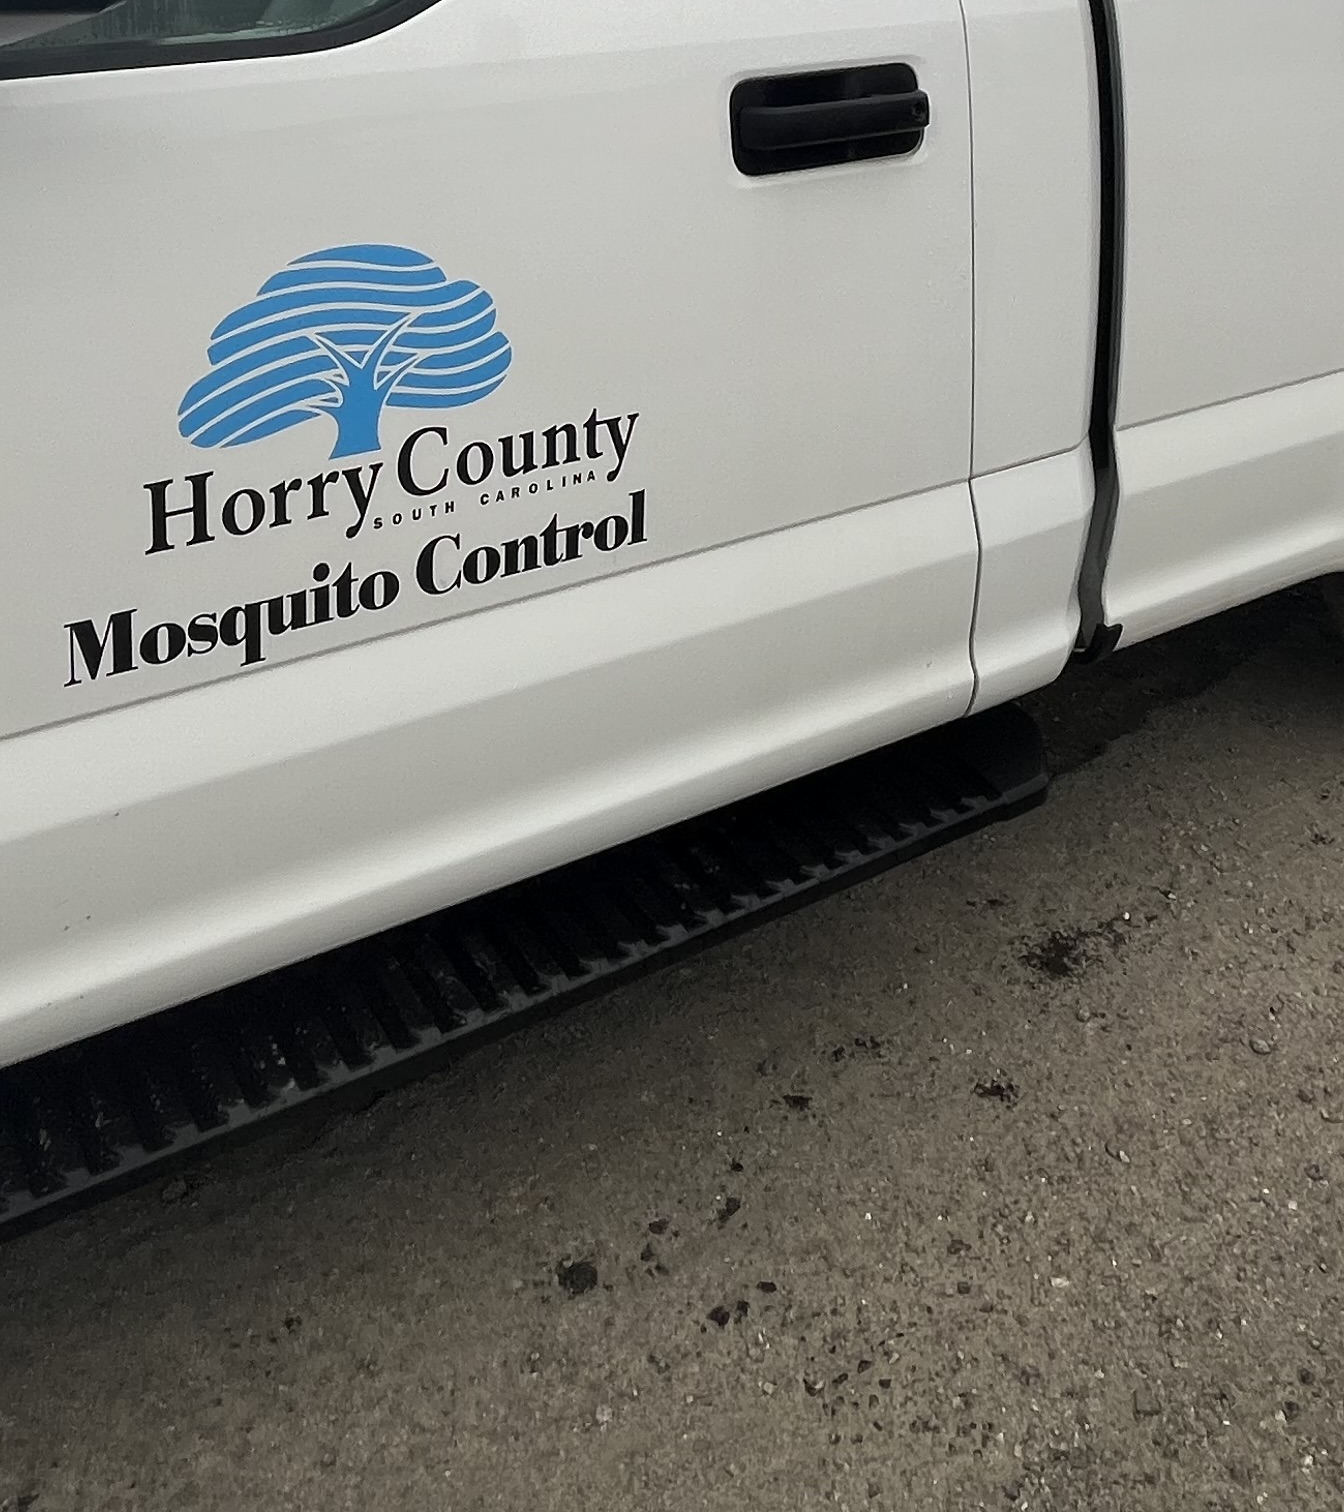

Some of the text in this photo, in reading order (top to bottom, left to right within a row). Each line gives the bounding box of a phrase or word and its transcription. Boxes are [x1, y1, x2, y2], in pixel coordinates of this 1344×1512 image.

[143, 408, 639, 555] Horry County
[373, 470, 596, 530] SOUTH CAROLINA
[64, 489, 647, 687] Mosquito Control
